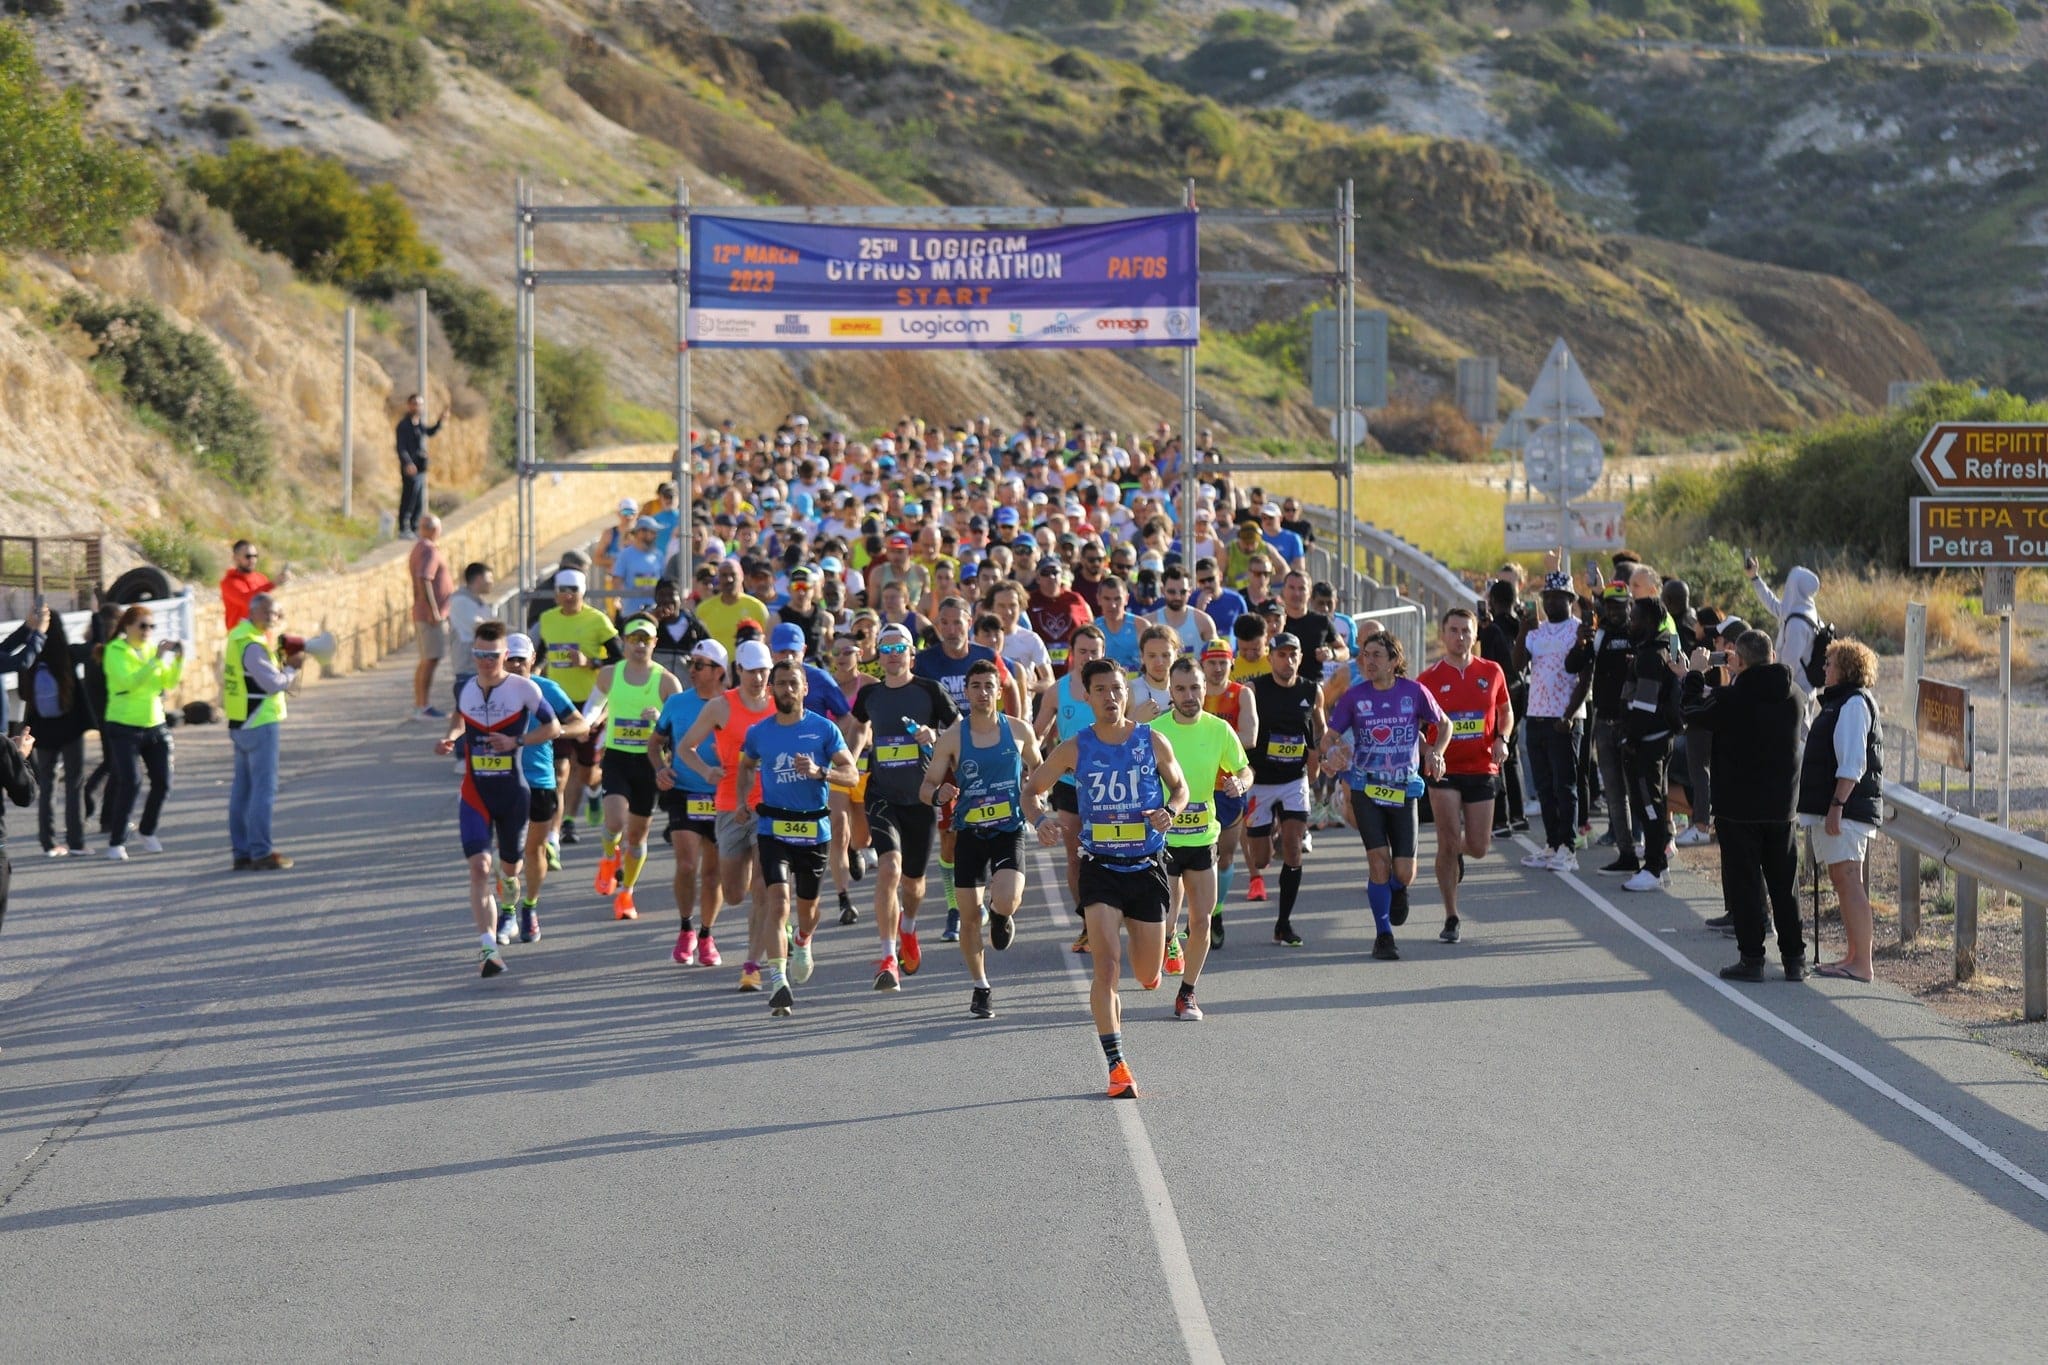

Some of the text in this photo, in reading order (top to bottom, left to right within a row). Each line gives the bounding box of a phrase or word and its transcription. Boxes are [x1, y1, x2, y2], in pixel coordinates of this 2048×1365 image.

[743, 246, 799, 265] MARCH
[859, 236, 1028, 261] 25TH LOGICOM
[826, 253, 1062, 281] CYPRUS MARATHON
[1107, 256, 1168, 280] PAFOS
[729, 270, 775, 292] 2023
[896, 287, 993, 306] START
[900, 314, 990, 339] Logicom
[1096, 318, 1149, 334] omega
[1966, 432, 2048, 454] ΠΕΡΙΠΤ
[1928, 507, 2013, 529] ΠΕΤΡΑ
[1928, 535, 1993, 557] Petra
[1365, 716, 1409, 726] INSPIRED BY
[1924, 698, 1959, 729] FRESH FISH
[622, 728, 642, 737] 264
[1455, 721, 1476, 731] 340
[892, 747, 899, 757] 7
[1278, 744, 1298, 754] 209
[480, 758, 501, 767] 179
[1374, 787, 1396, 799] 297
[980, 807, 996, 818] 10
[1176, 814, 1200, 824] 356
[784, 823, 808, 833] 346
[1114, 825, 1121, 837] 1
